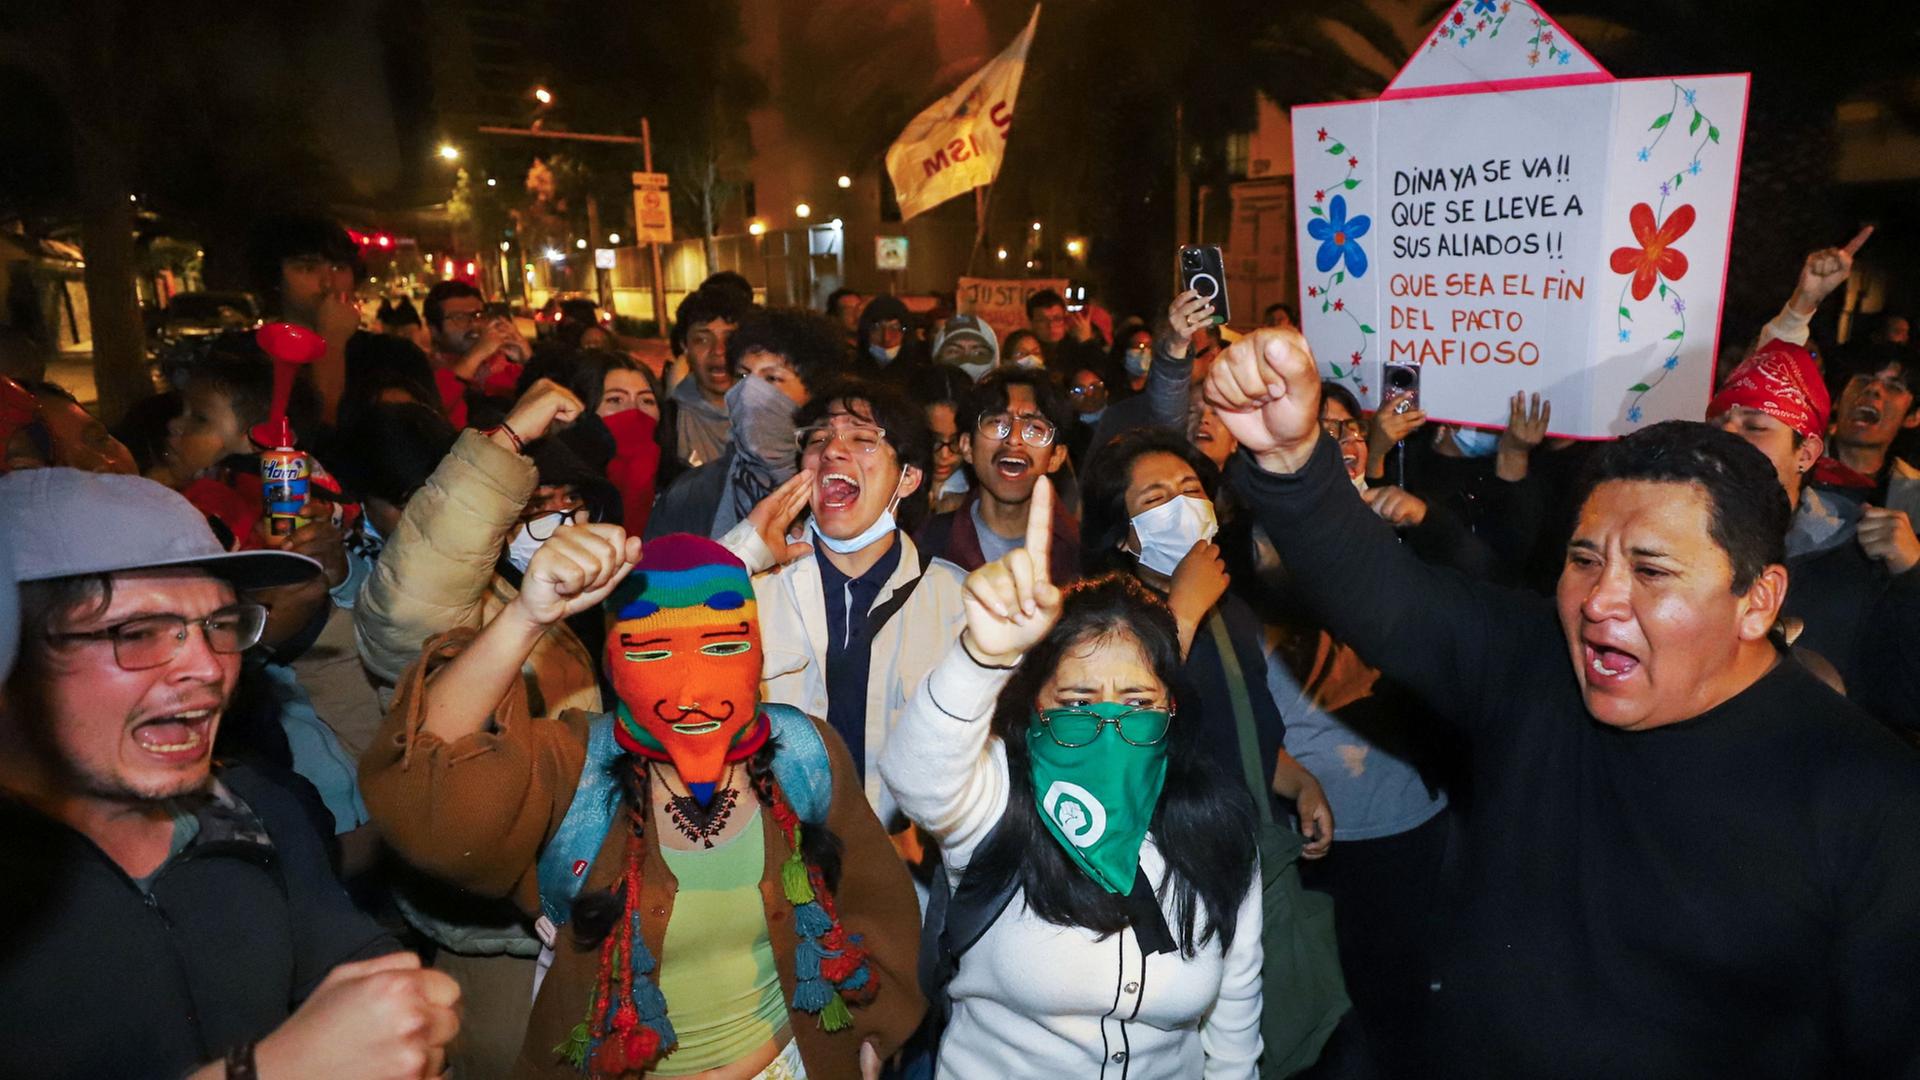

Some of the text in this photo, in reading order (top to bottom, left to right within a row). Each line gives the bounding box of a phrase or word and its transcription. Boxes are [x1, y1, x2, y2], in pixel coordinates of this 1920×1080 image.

[1483, 160, 1511, 182] SE
[1522, 154, 1569, 182] VA!!
[1392, 195, 1583, 227] QUE SE LLEVE A
[1393, 232, 1562, 259] SUS ALIADOS!!
[1390, 274, 1438, 297] QUE
[1445, 273, 1495, 296] SEA
[1503, 274, 1535, 296] EL
[1391, 305, 1522, 332] DEL PACTO
[1390, 339, 1539, 366] MAFIOSO
